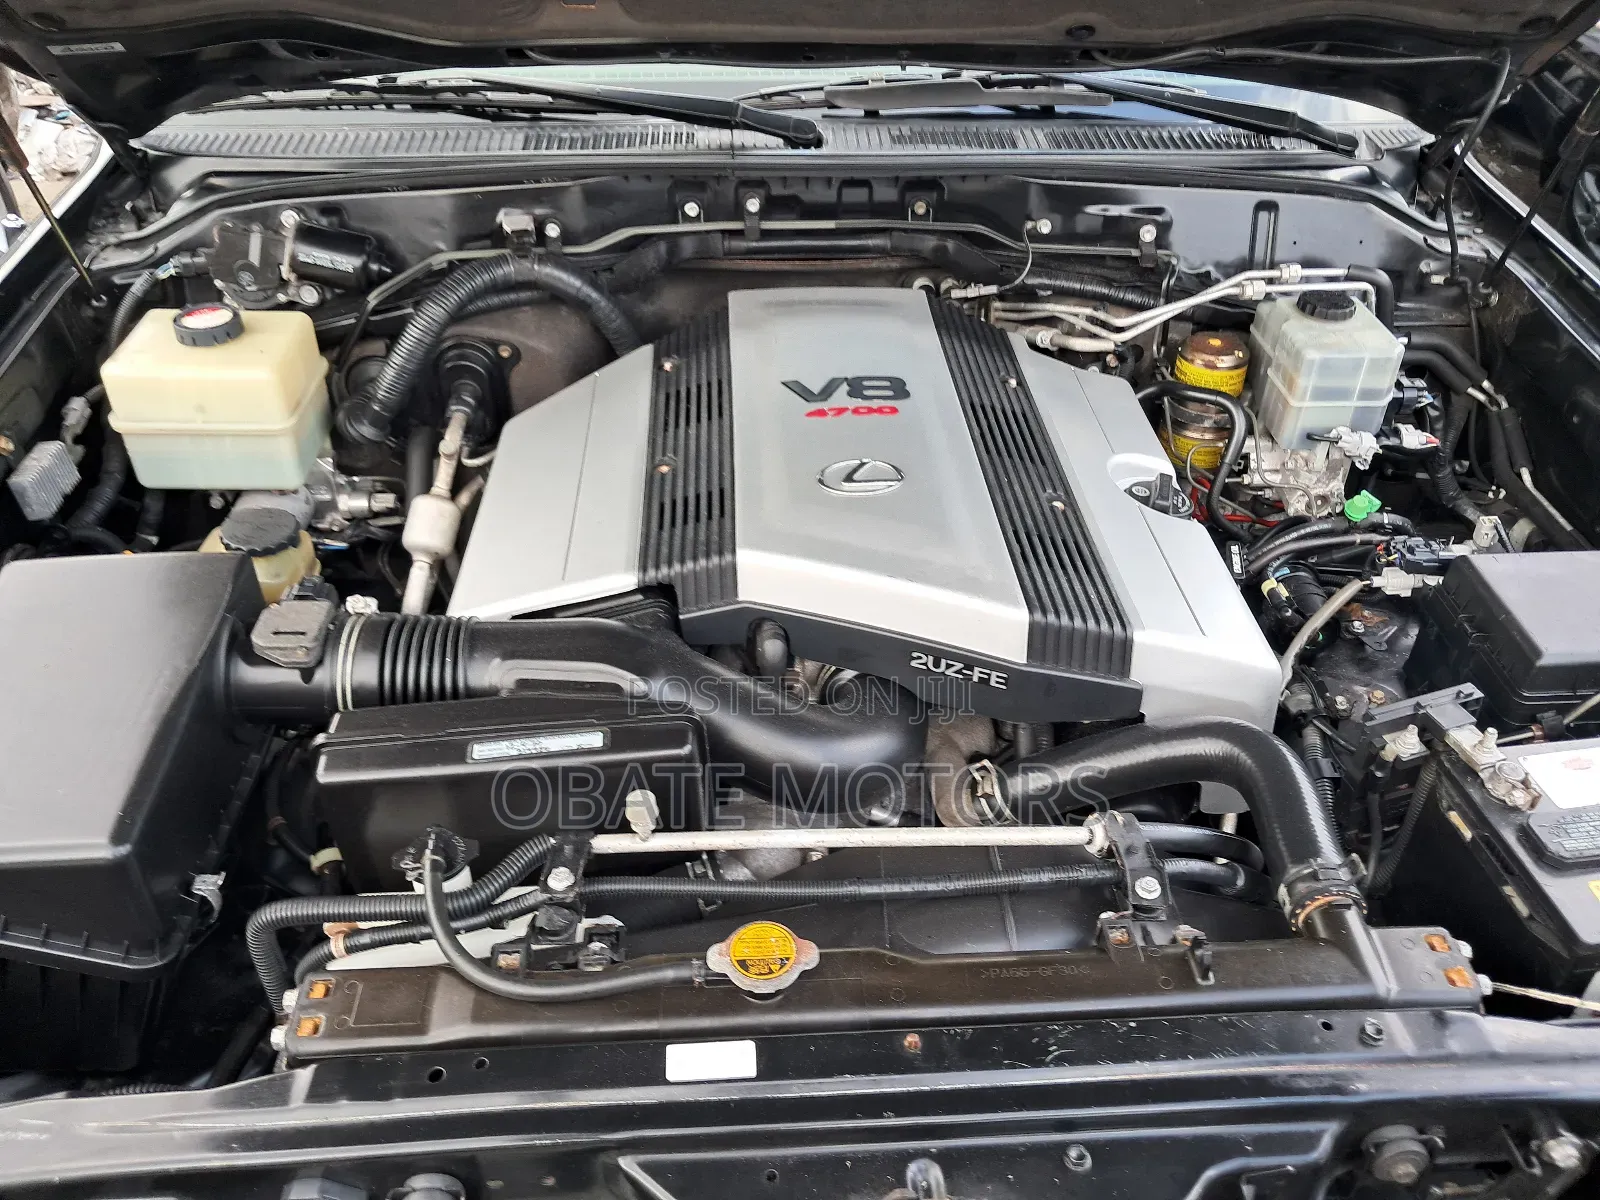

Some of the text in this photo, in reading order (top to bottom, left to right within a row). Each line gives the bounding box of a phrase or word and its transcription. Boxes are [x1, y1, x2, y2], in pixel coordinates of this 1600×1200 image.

[780, 376, 911, 403] V8
[804, 405, 900, 418] 4700
[909, 651, 1009, 690] 2UZ-FE
